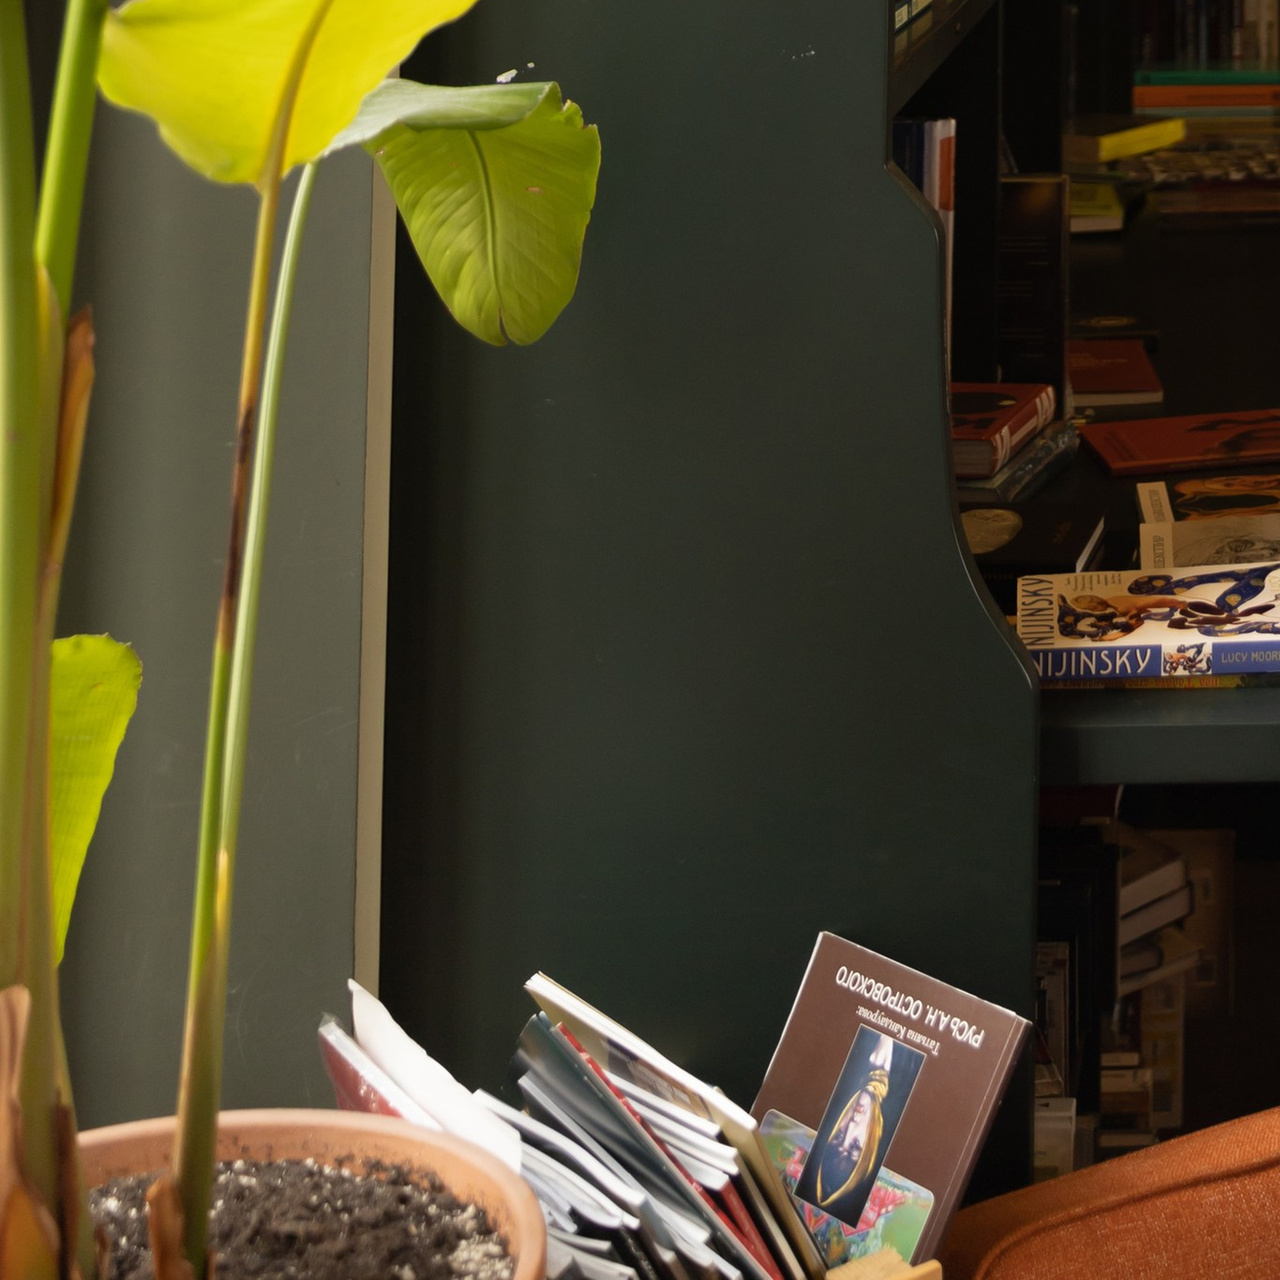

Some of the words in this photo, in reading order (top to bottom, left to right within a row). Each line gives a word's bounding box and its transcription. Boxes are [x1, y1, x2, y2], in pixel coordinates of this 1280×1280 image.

[1020, 577, 1055, 647] NIJINSKY
[1036, 647, 1153, 678] NIJINSKY
[1221, 651, 1248, 665] LUCY
[835, 965, 923, 1020] ОСТРОВСКОГО
[906, 1029, 941, 1056] Татьяна
[949, 1017, 986, 1050] РУСЬ
